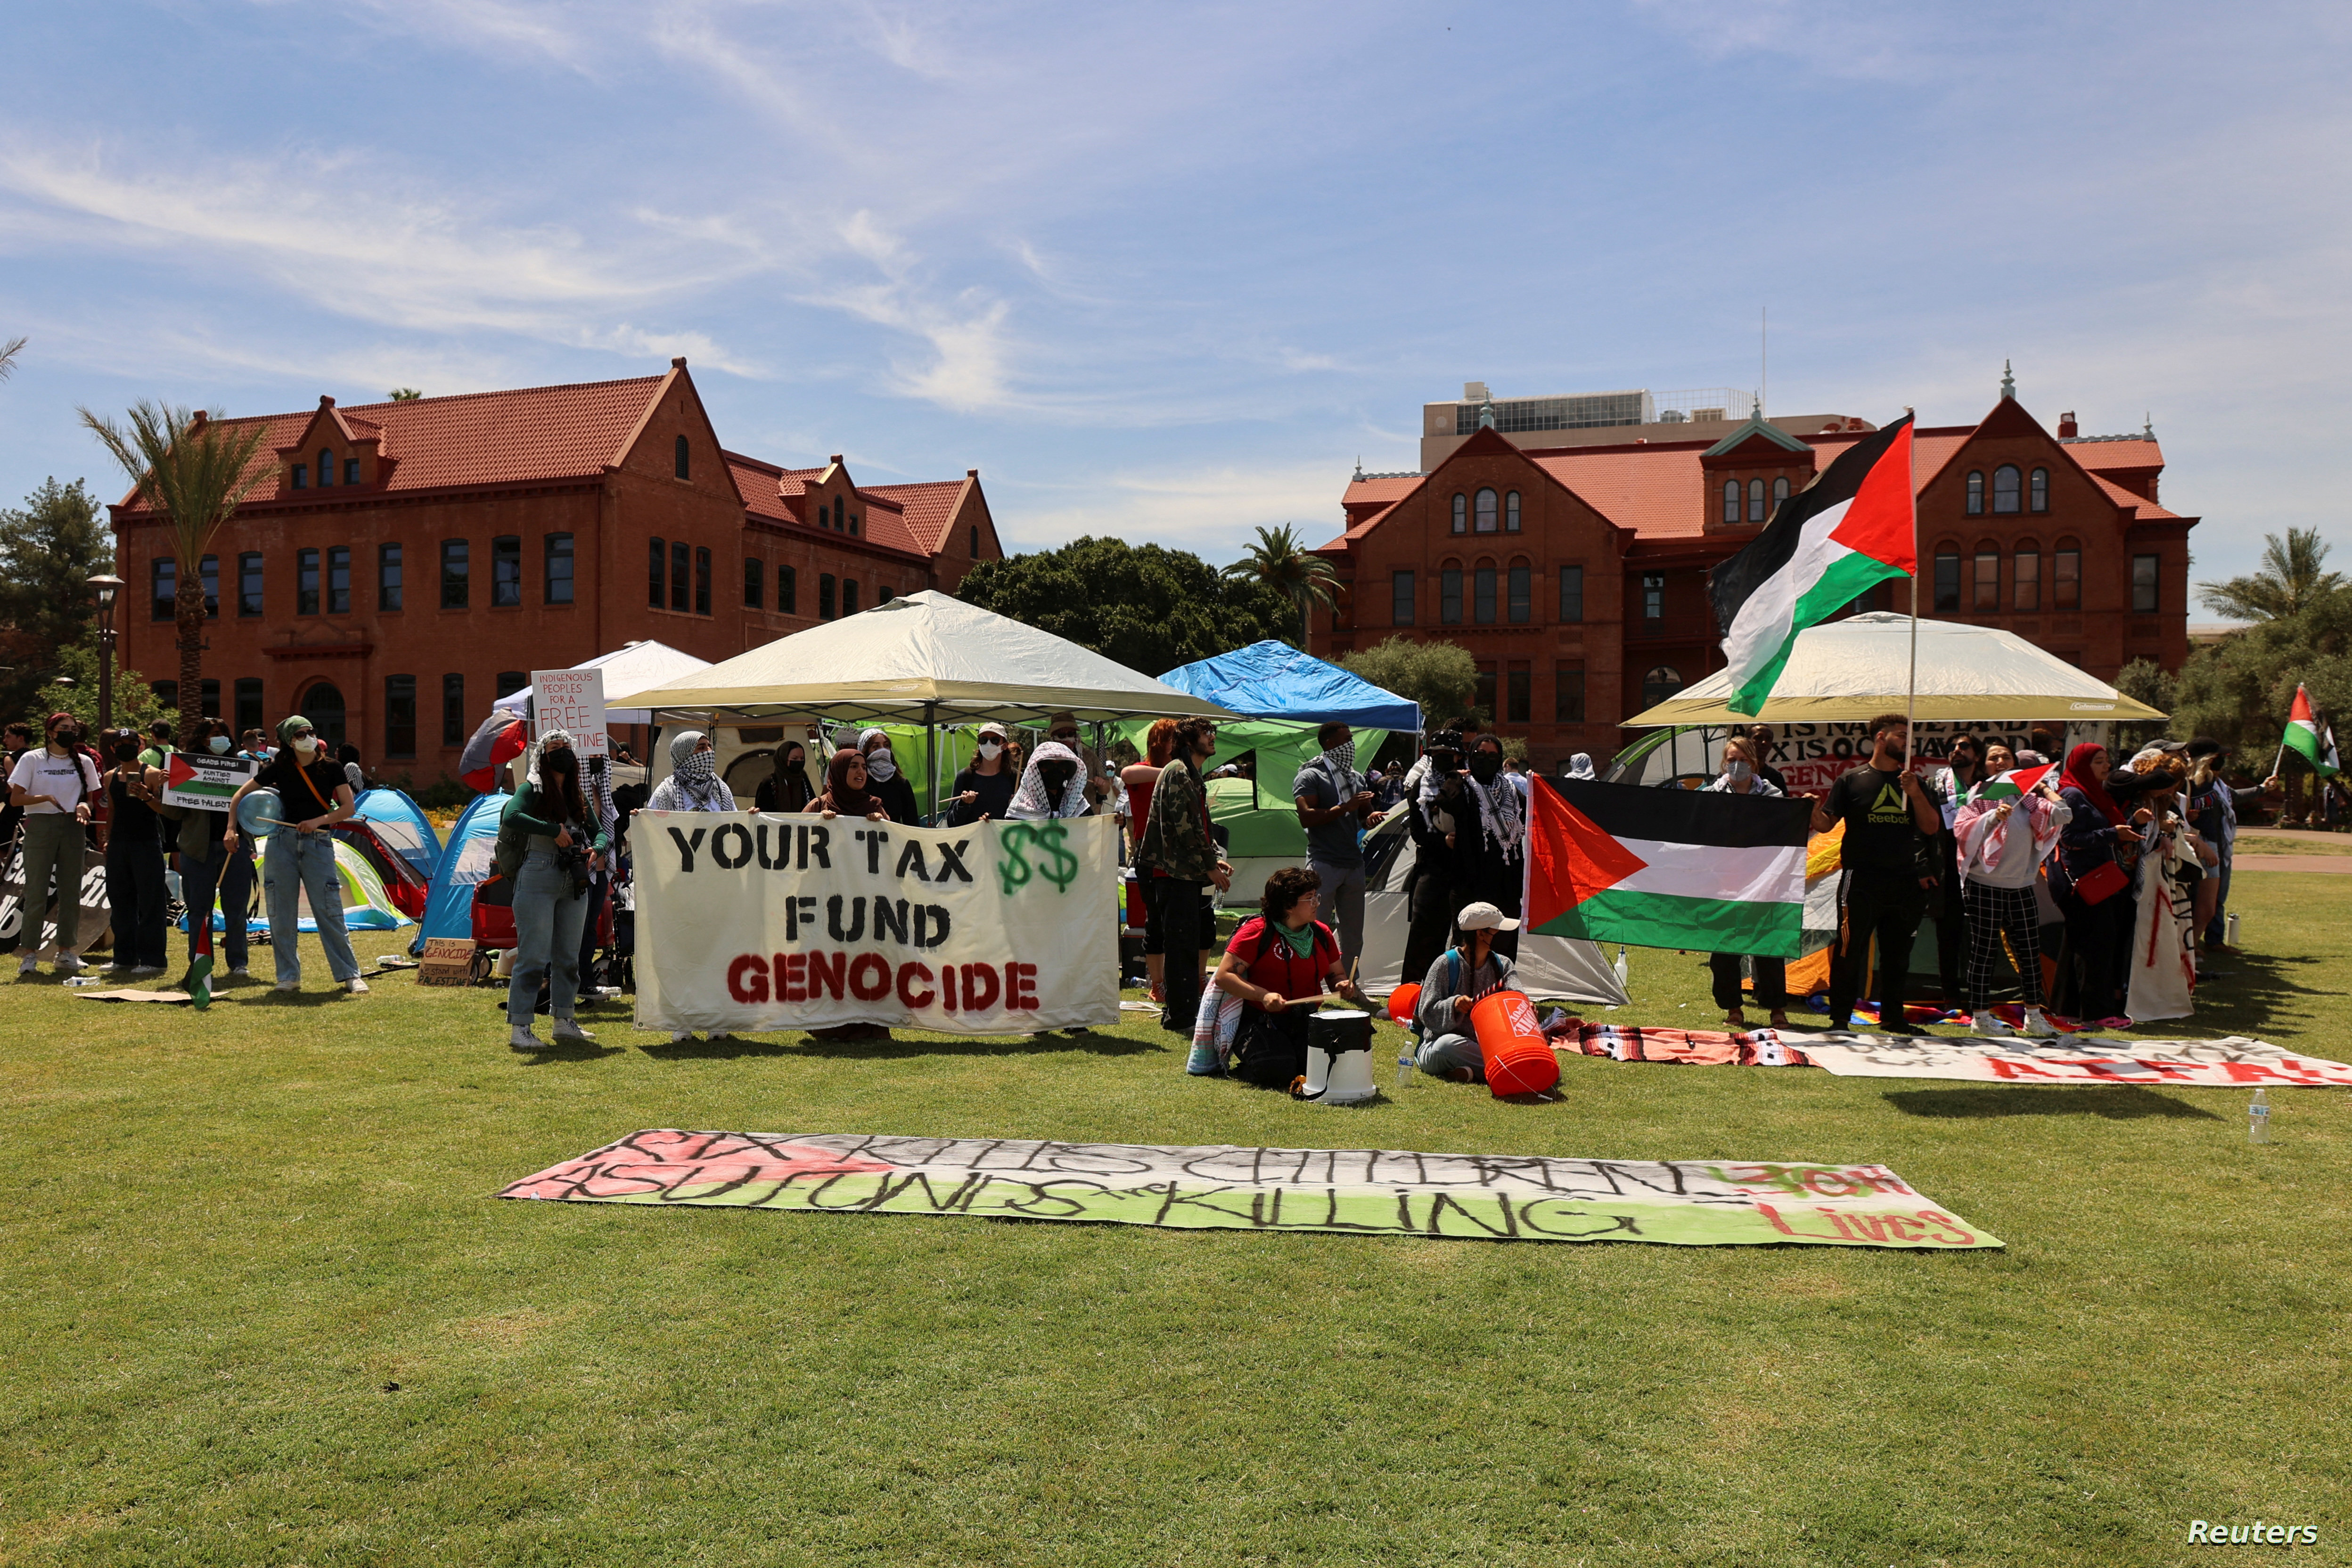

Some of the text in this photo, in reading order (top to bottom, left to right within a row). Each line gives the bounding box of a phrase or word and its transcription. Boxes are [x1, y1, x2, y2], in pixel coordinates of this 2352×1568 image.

[540, 673, 593, 683] INDIGENOUS
[543, 684, 582, 694] PEOPLES
[550, 695, 575, 705] FOR A
[540, 706, 591, 730] FREE
[1795, 739, 1827, 761] IS
[203, 770, 231, 778] AUNTIES
[177, 796, 231, 808] FREE PALEST
[1868, 813, 1909, 825] Reebok
[667, 819, 1079, 895] YOUR TAX $$
[785, 895, 951, 950] FUND
[425, 948, 474, 960] GENOCIDE
[431, 967, 449, 975] stand
[418, 975, 467, 986] PALESTINE
[727, 948, 1040, 1012] GENOCIDE
[1510, 1000, 1529, 1022] DEPOT
[834, 1135, 1175, 1176] KILLS
[1183, 1147, 1686, 1195] CHILDREN
[496, 1162, 760, 1201] ASU
[749, 1169, 1109, 1216] FUNDS
[1154, 1180, 1646, 1238] KILLING
